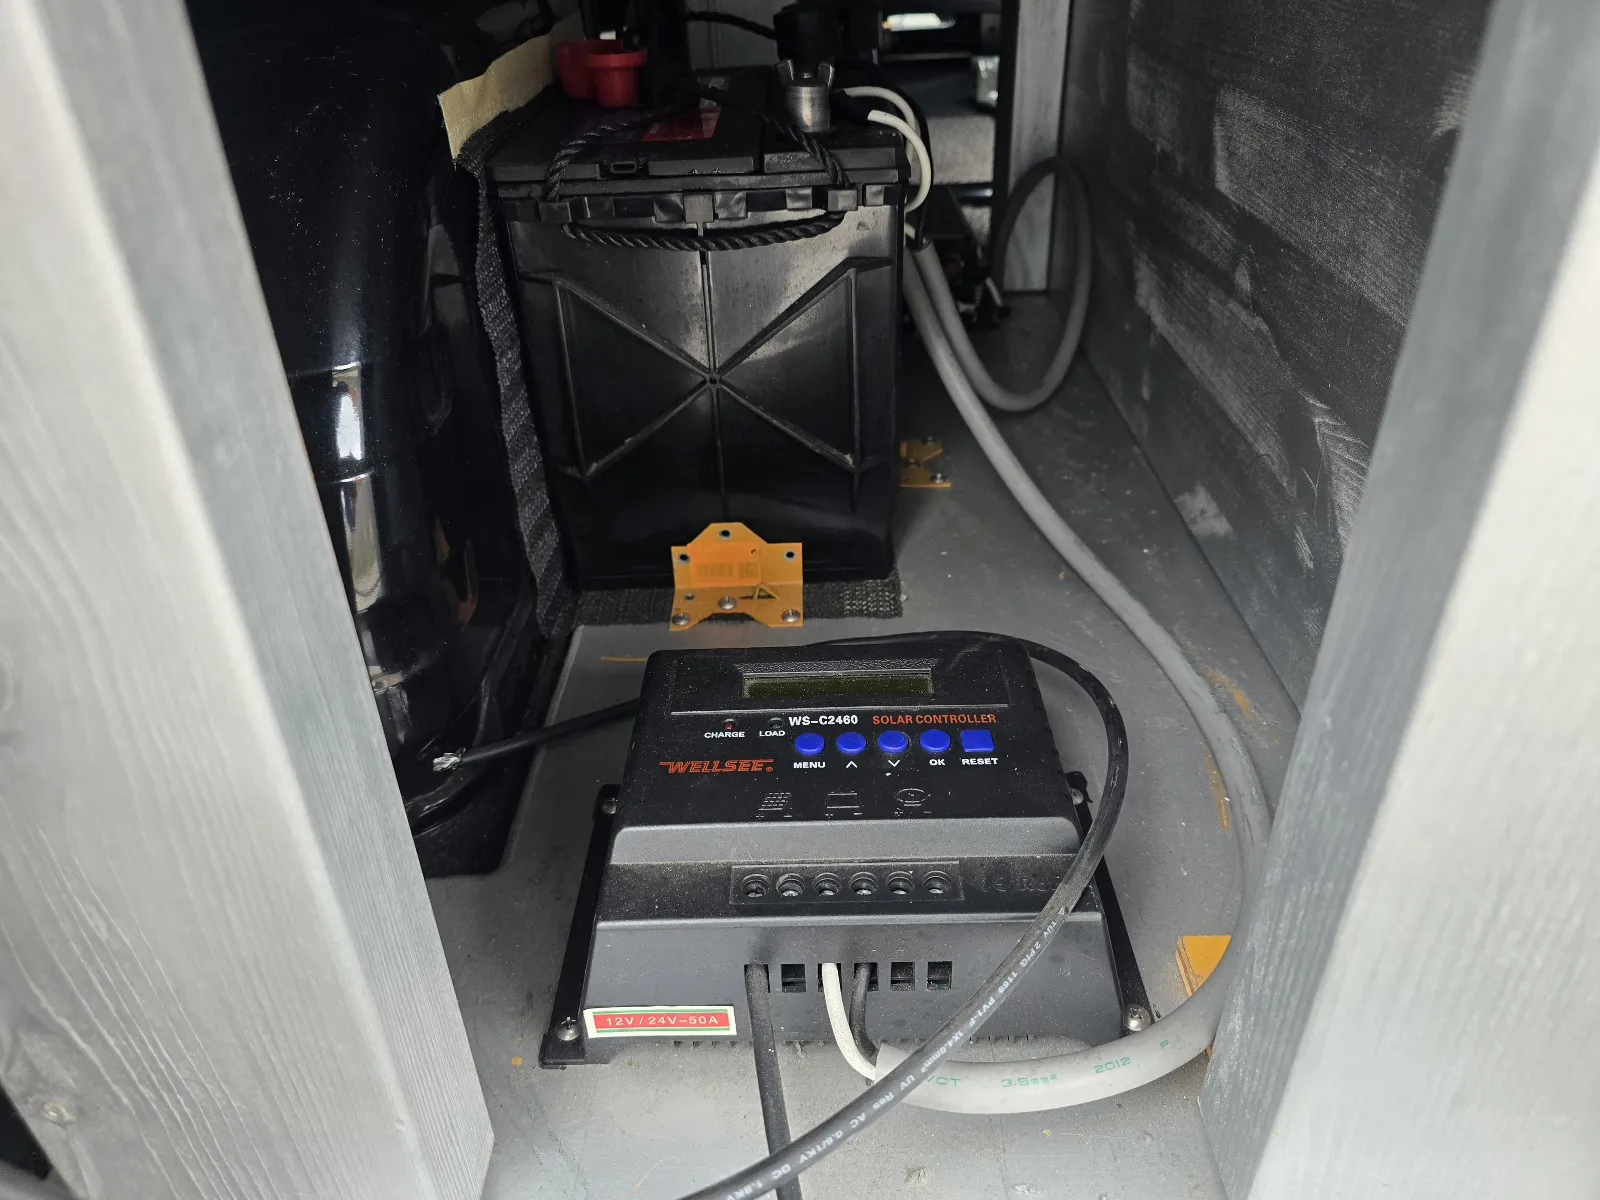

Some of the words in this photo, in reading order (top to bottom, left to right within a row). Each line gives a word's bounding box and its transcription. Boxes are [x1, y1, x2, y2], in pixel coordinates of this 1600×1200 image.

[789, 714, 859, 727] WS-C2460
[872, 715, 913, 725] SOLAR
[915, 713, 997, 725] CONTROLLER
[704, 731, 746, 739] CHARGE
[793, 761, 826, 769] MENU
[929, 758, 946, 766] OK
[961, 757, 999, 766] RESET
[998, 971, 1018, 994] 1169
[969, 996, 996, 1027] PV1-F
[1093, 1056, 1132, 1074] 2012
[900, 1074, 916, 1090] UV
[872, 1091, 894, 1110] Res
[849, 1112, 866, 1129] AC
[771, 1163, 792, 1180] DC
